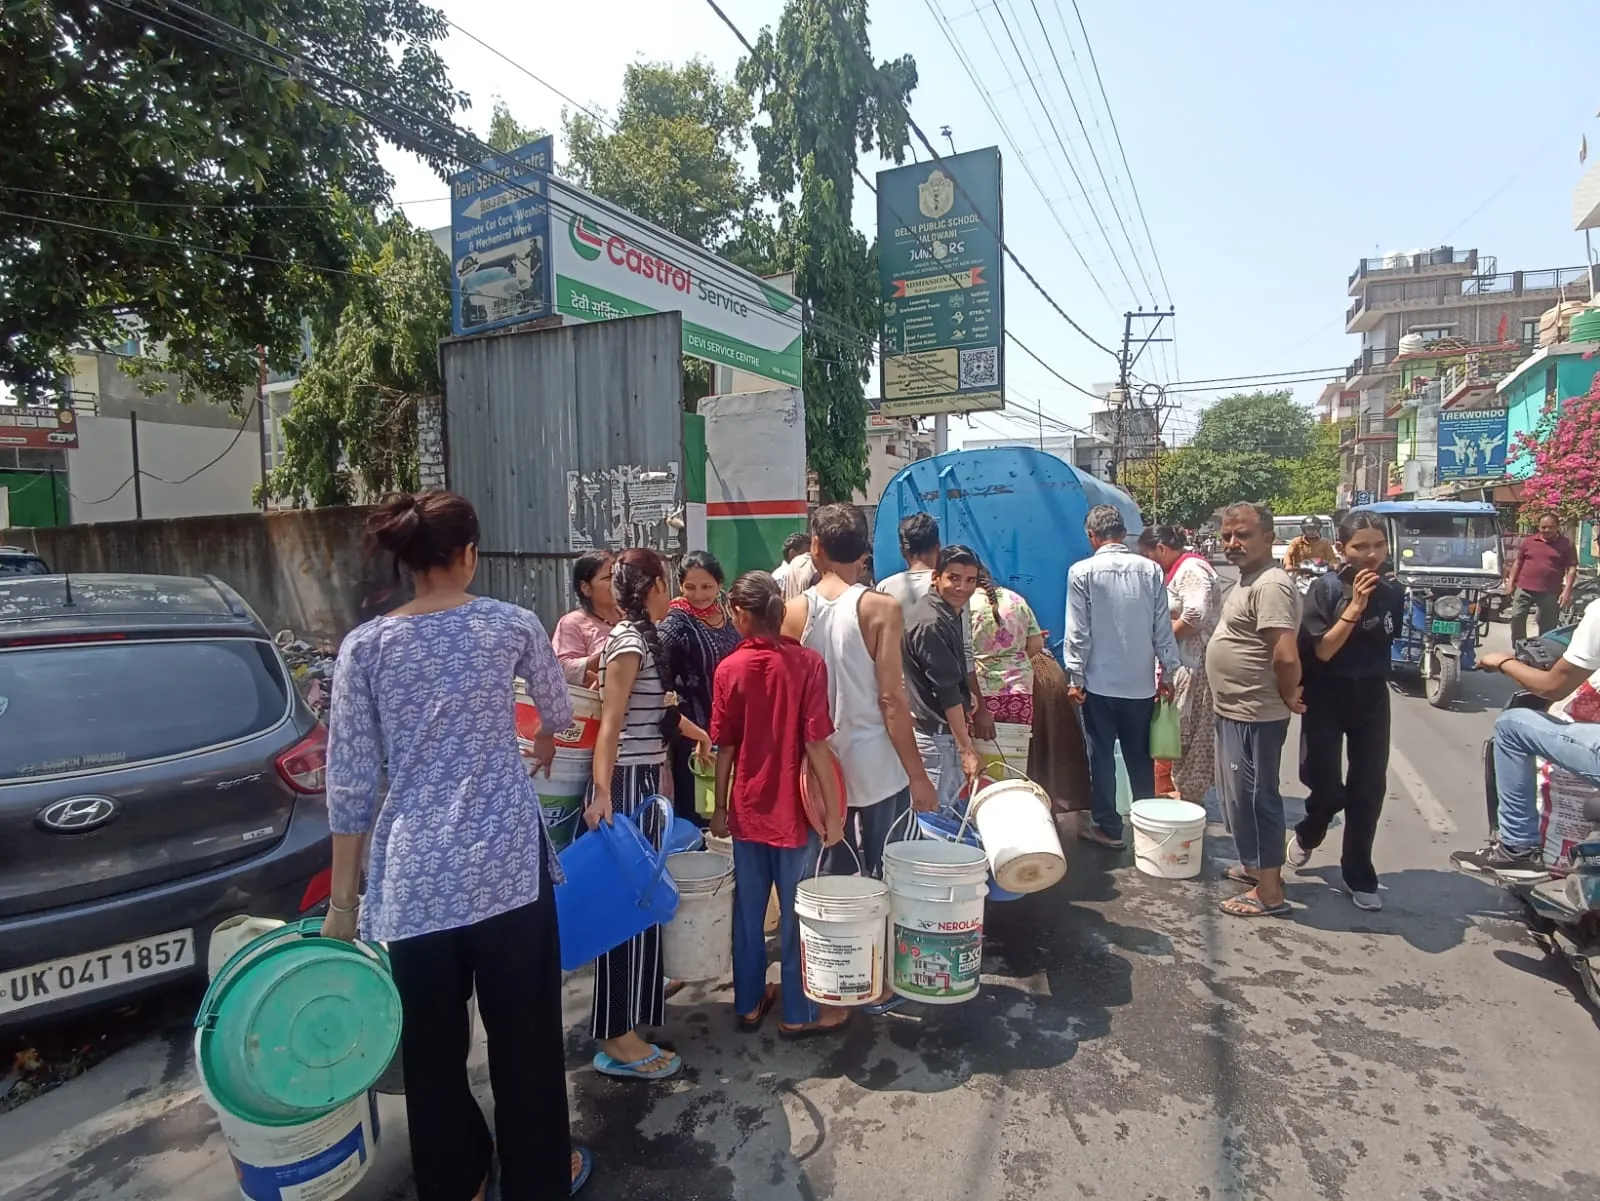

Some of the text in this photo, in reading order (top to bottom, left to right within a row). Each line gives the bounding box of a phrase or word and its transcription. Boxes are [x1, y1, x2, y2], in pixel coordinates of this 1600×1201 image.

[455, 175, 474, 199] Devi
[485, 220, 497, 231] Car
[513, 222, 533, 237] Work
[918, 219, 946, 233] PUBLIC
[947, 213, 980, 227] SCHOOL
[607, 236, 692, 295] Castrol
[905, 274, 948, 289] ADMISSION
[949, 271, 971, 282] OPEN
[571, 289, 590, 312] देवी
[698, 281, 748, 318] Service
[688, 335, 760, 367] DEVI SERVICE CENTRE
[11, 407, 57, 417] CENTER
[1441, 409, 1505, 420] TAEKWONDO
[10, 938, 187, 1001] UK 04T 1857
